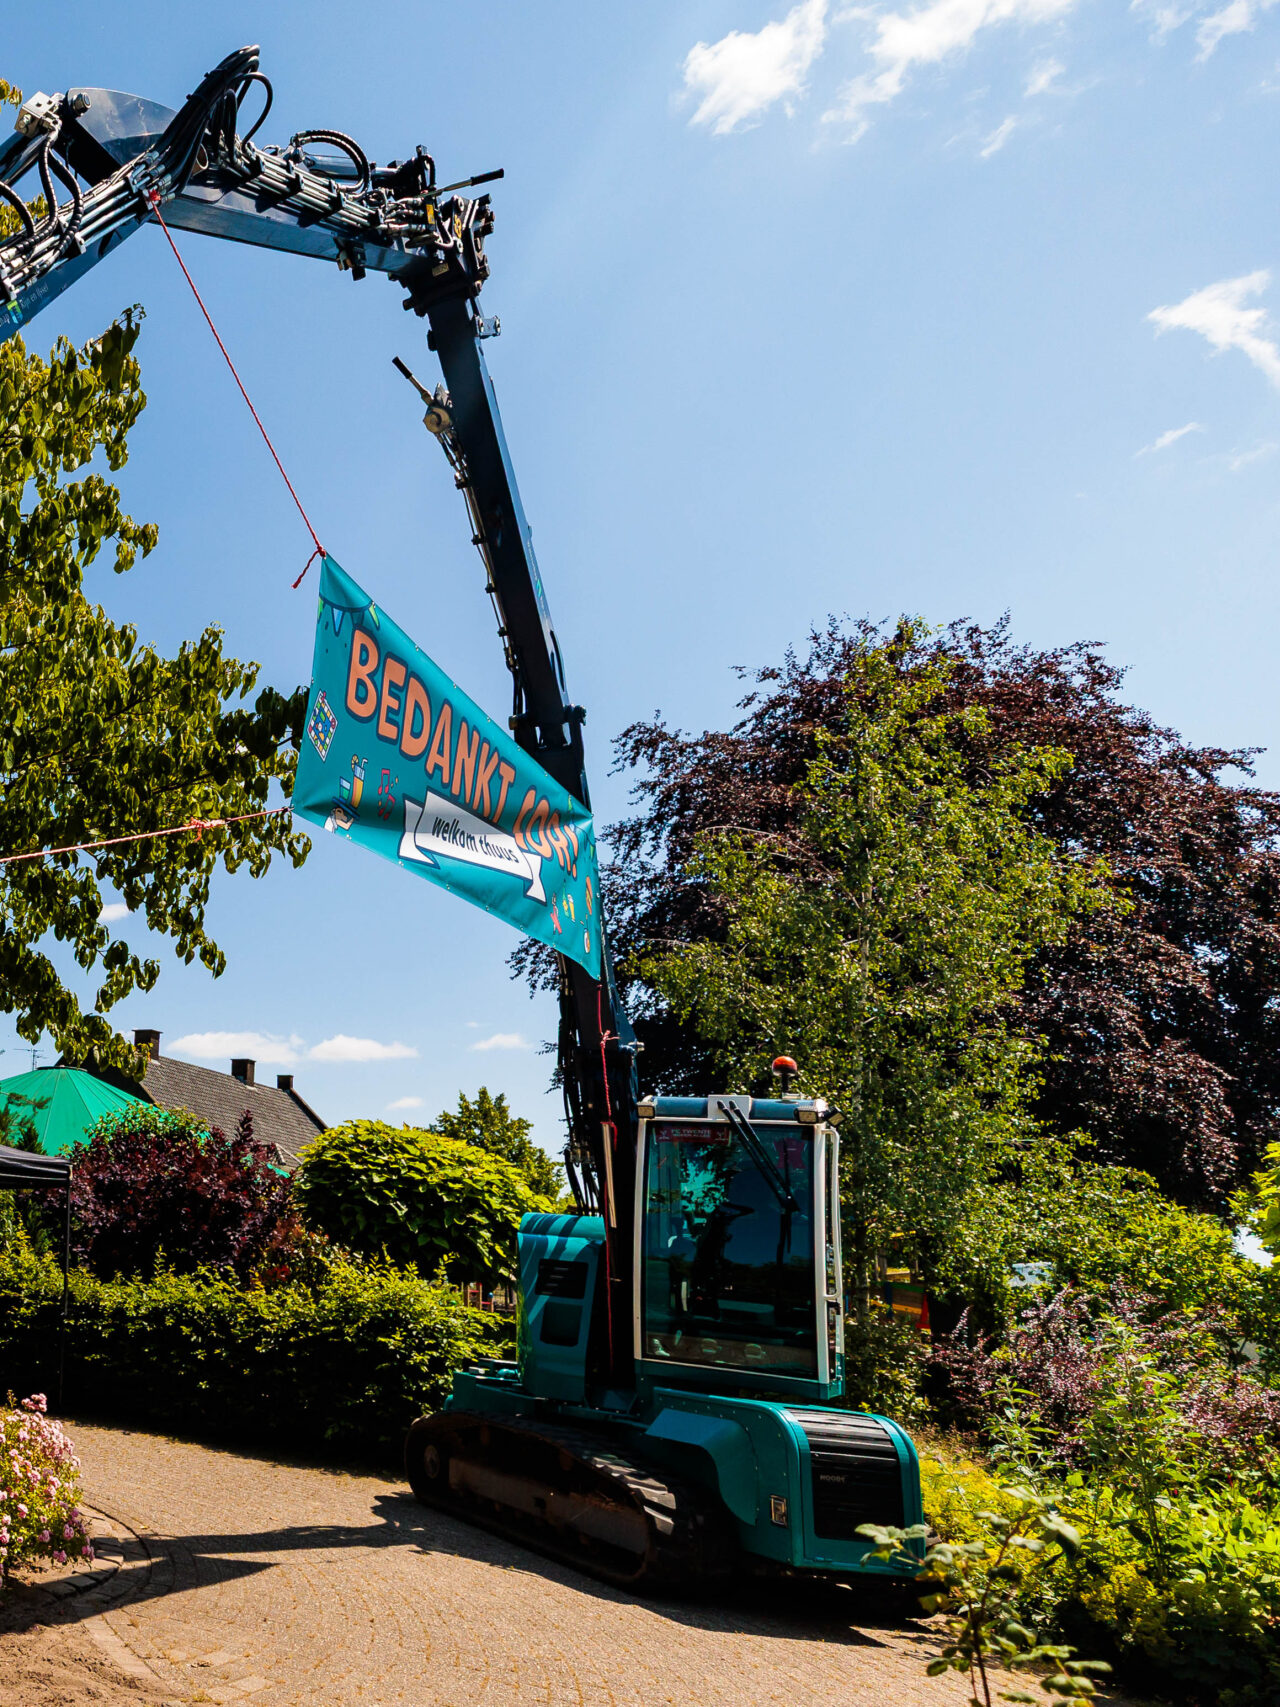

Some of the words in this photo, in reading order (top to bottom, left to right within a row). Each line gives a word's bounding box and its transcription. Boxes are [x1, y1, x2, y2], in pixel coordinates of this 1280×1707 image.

[346, 626, 516, 824] BEDANKT
[431, 816, 479, 853] welkom
[479, 834, 520, 864] thuus
